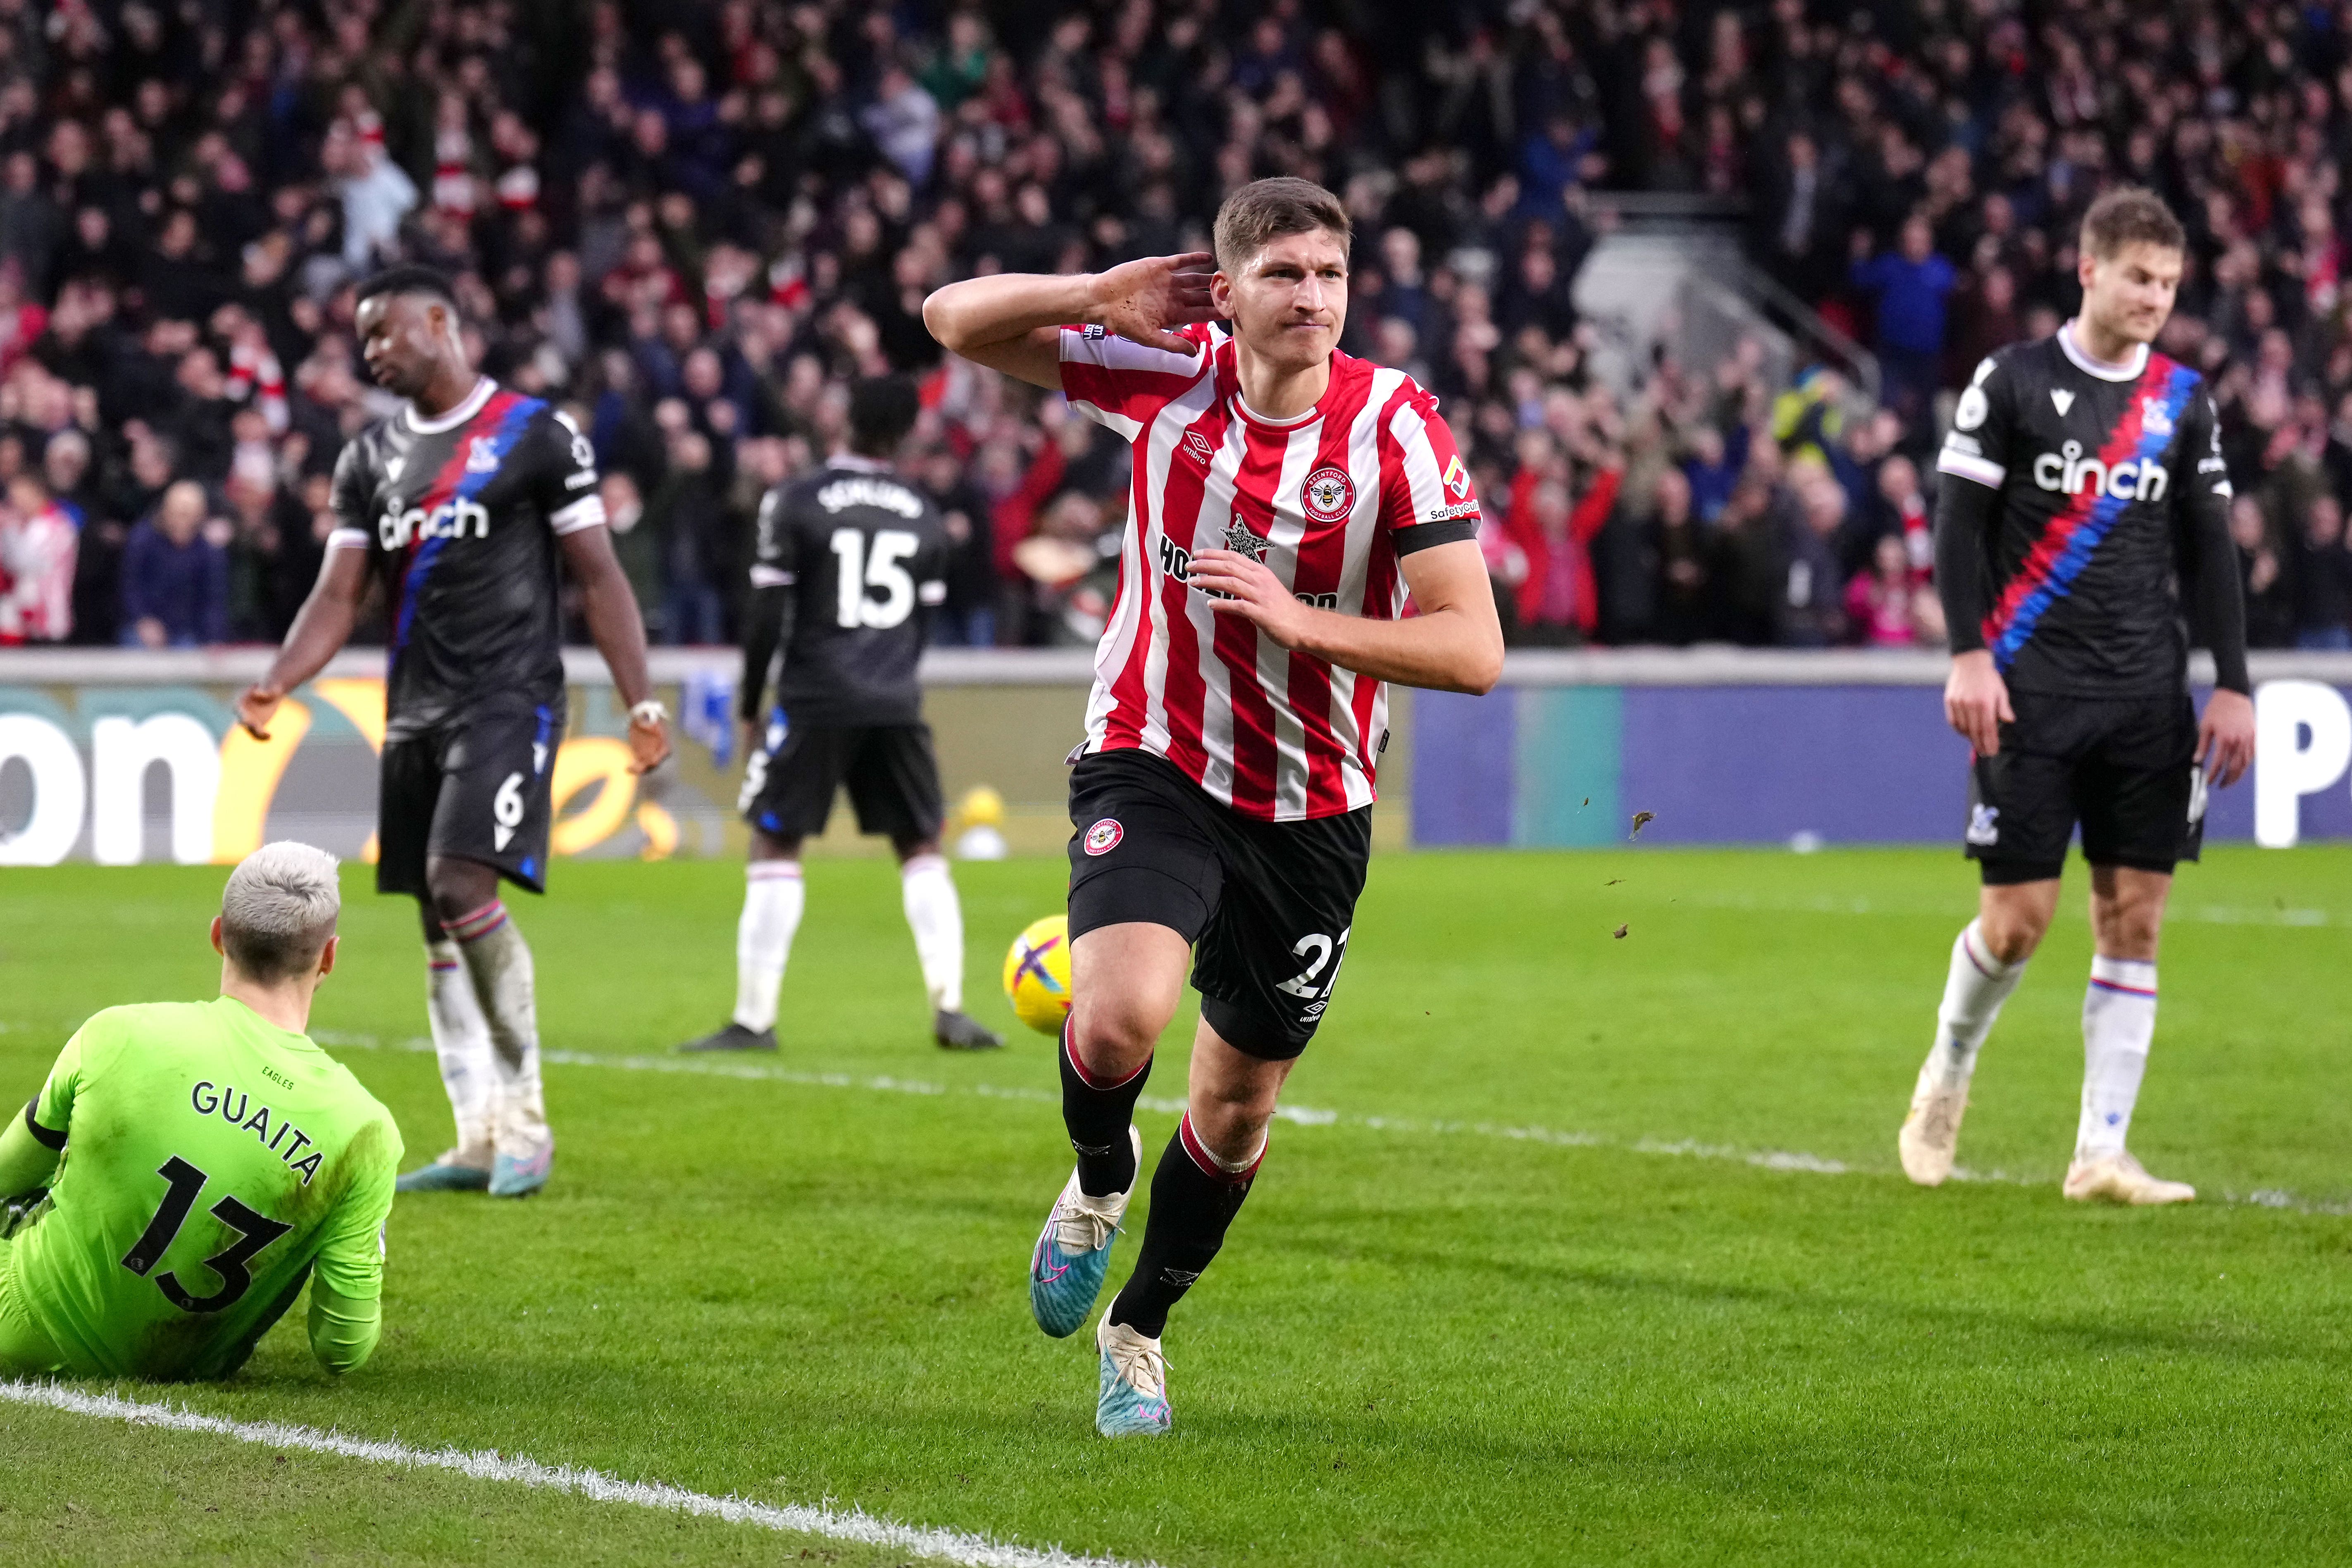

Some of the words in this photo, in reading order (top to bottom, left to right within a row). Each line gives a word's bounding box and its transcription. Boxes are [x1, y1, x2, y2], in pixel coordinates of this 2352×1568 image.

[1183, 444, 1206, 465] umbro
[1308, 471, 1346, 485] BRENTFORD
[2033, 439, 2169, 501] cinch
[379, 497, 489, 551] cinch
[1308, 507, 1334, 519] FOOTBALL
[1335, 505, 1348, 516] CLUB
[829, 527, 920, 630] 15
[2254, 680, 2352, 848] P
[493, 771, 525, 827] 6
[1300, 1014, 1320, 1022] umbro
[262, 1066, 294, 1090] EAGLES
[191, 1081, 323, 1187] GUAITA
[120, 1154, 295, 1314] 13
